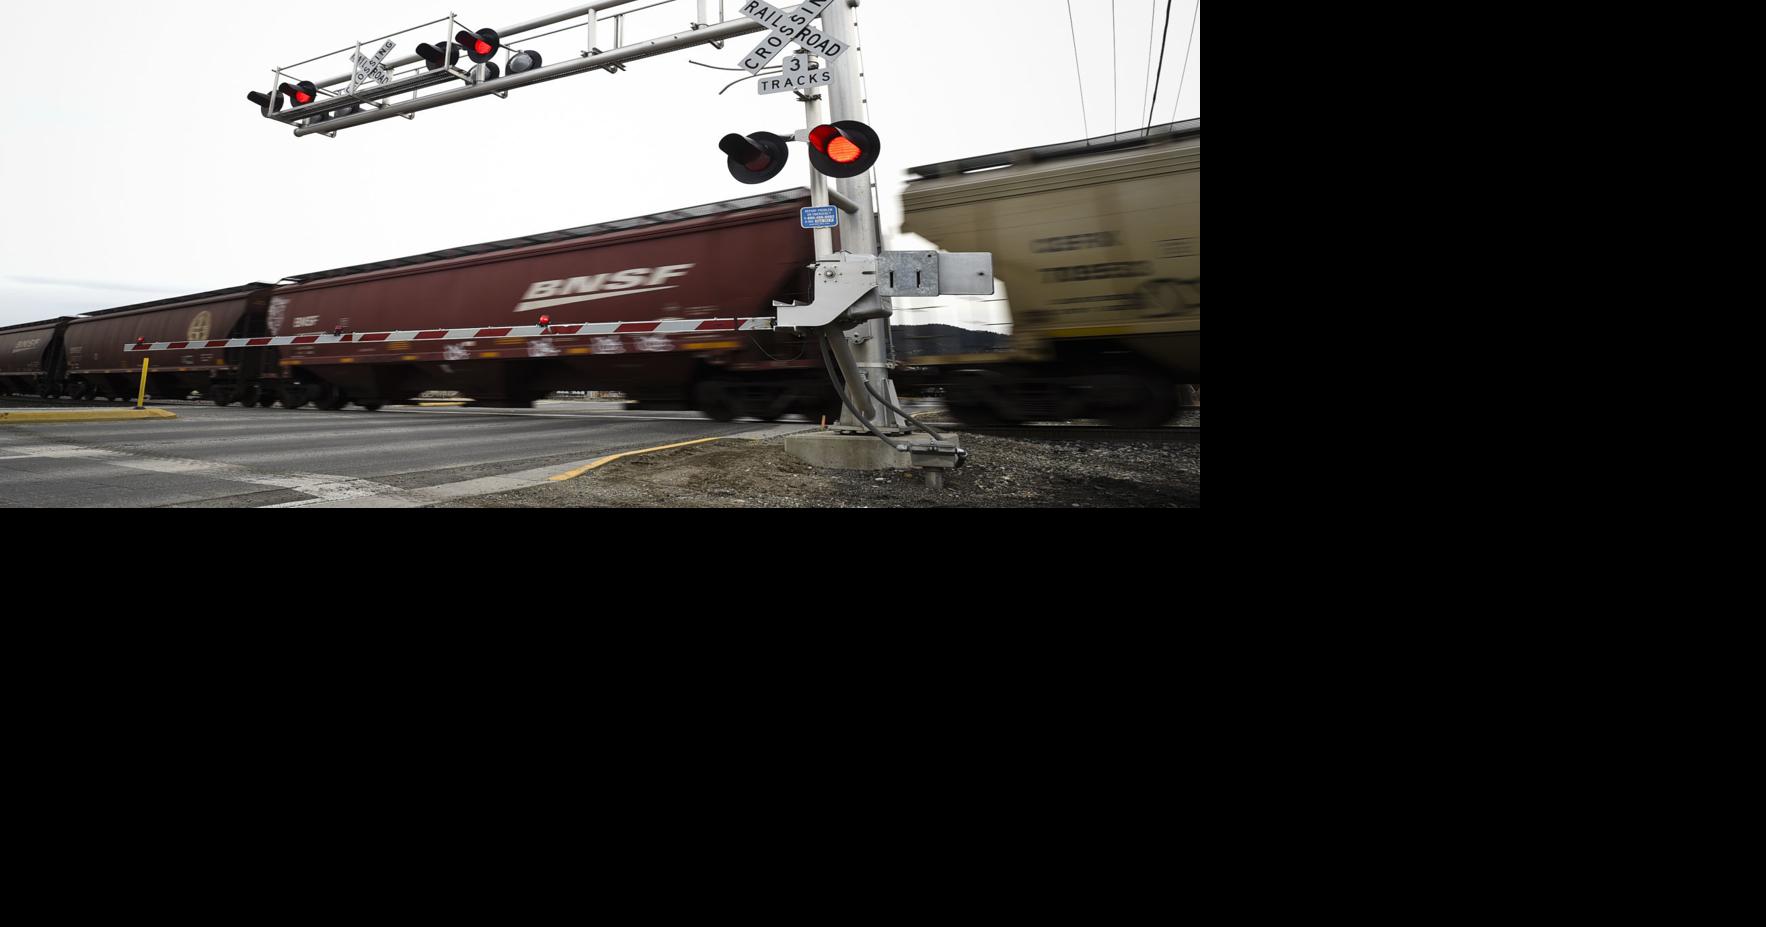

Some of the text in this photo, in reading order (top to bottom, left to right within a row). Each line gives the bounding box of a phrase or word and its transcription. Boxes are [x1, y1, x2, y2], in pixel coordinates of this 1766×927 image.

[744, 0, 841, 57] RAIL ROAD
[744, 0, 827, 70] CROSSIN
[345, 41, 393, 94] COSSING
[761, 71, 831, 91] TRACKS
[790, 58, 800, 71] 3
[522, 263, 696, 300] BNSF
